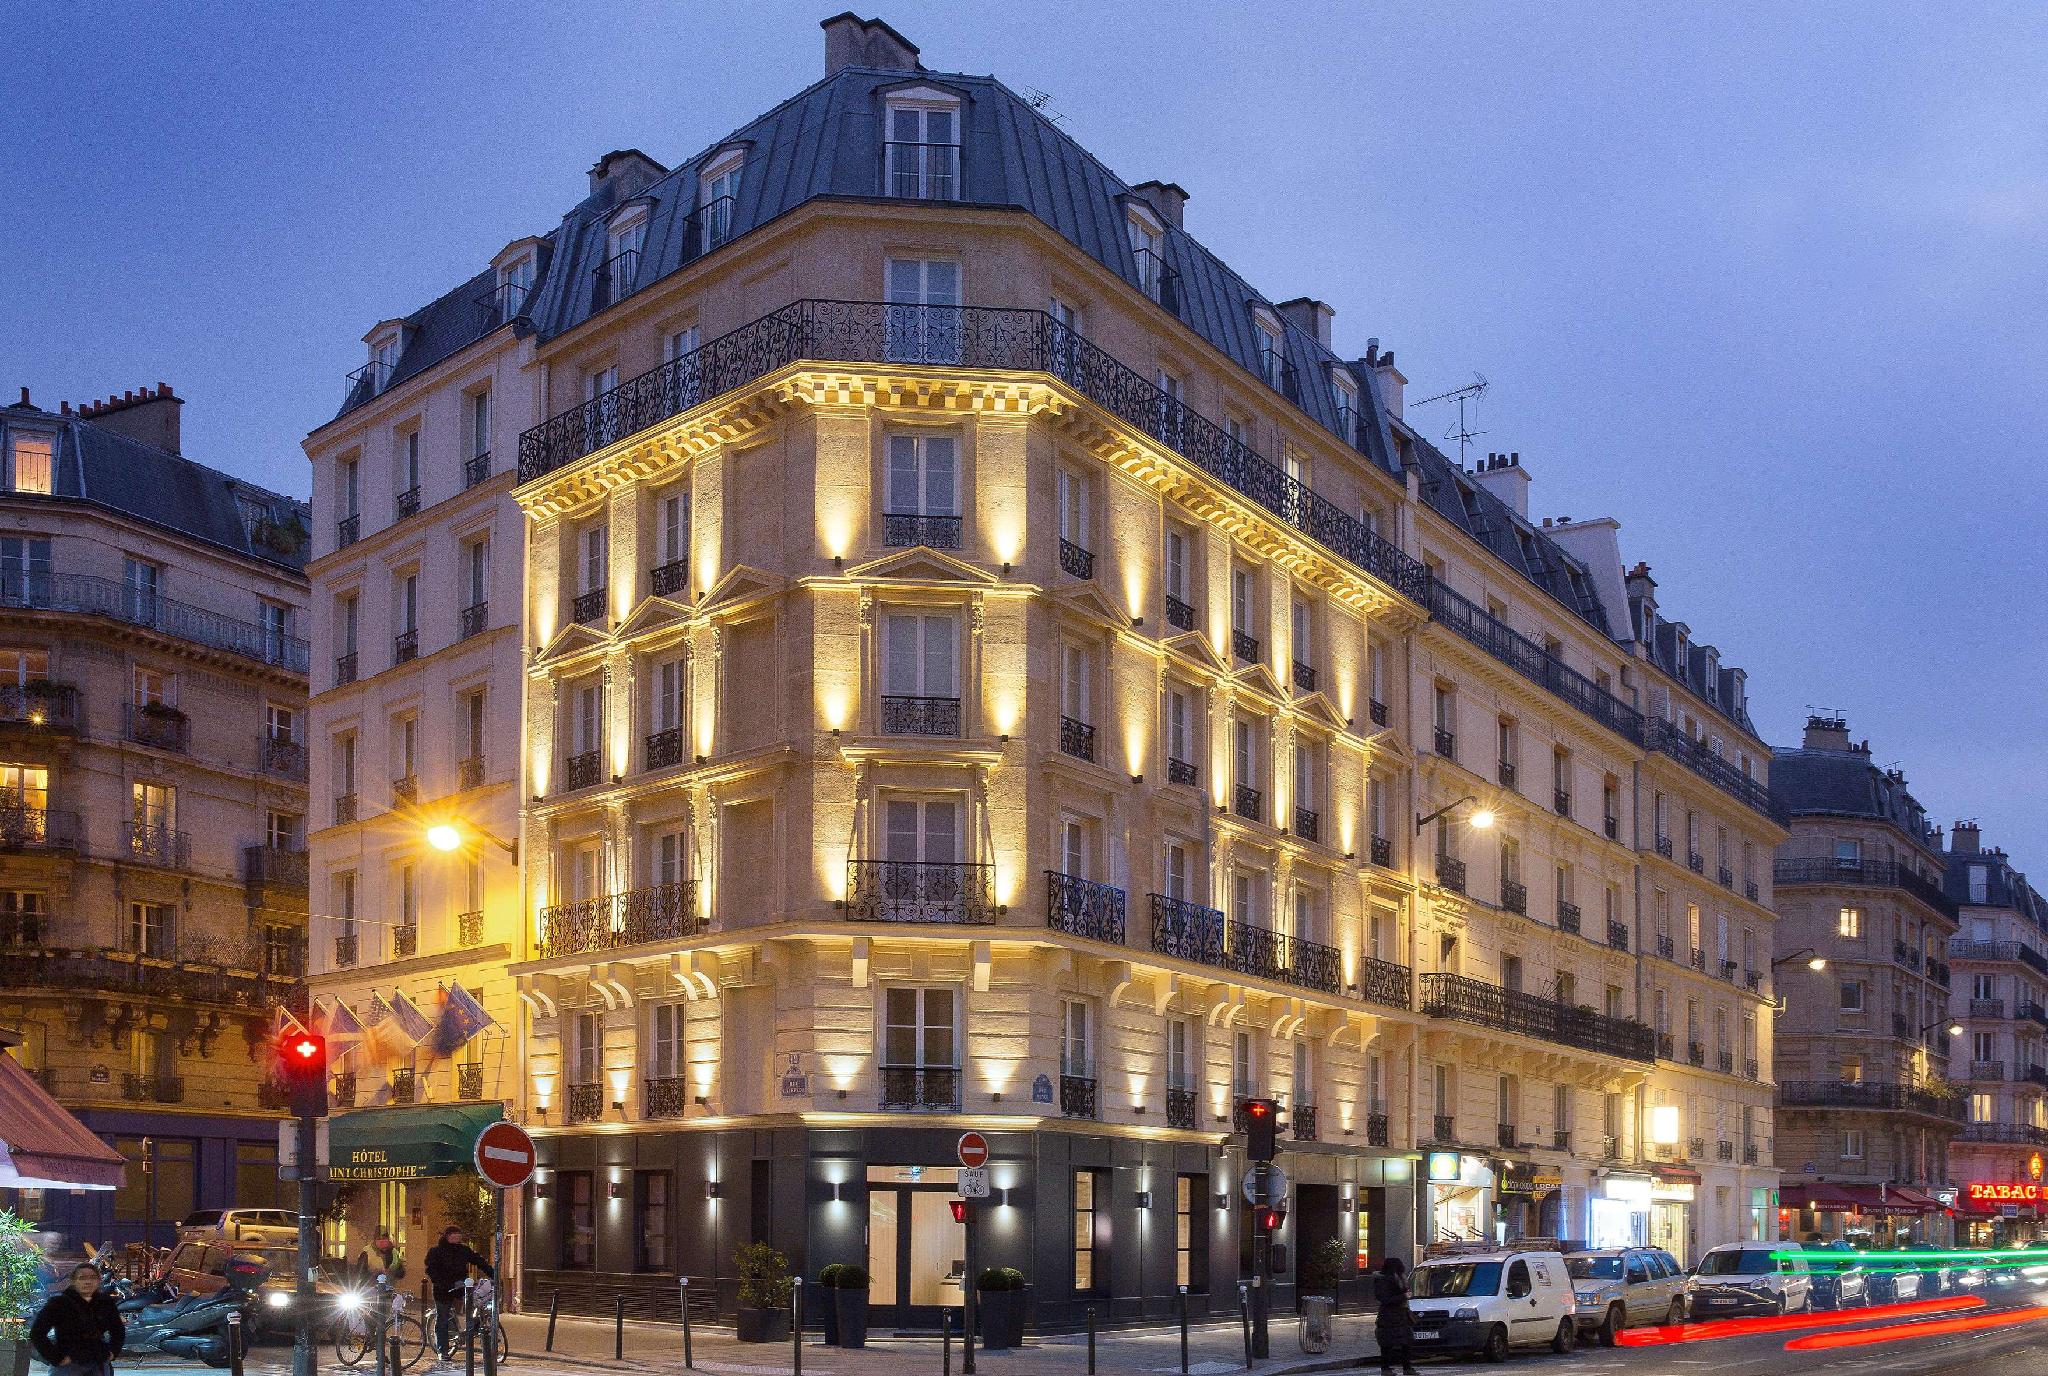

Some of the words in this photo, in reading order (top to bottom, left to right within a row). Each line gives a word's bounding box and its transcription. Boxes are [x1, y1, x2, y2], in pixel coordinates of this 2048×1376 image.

[352, 1149, 387, 1163] HÔTEL
[353, 1165, 417, 1178] CHRISTOPHE
[964, 1170, 984, 1178] SAUF
[1971, 1184, 2037, 1199] TABAC
